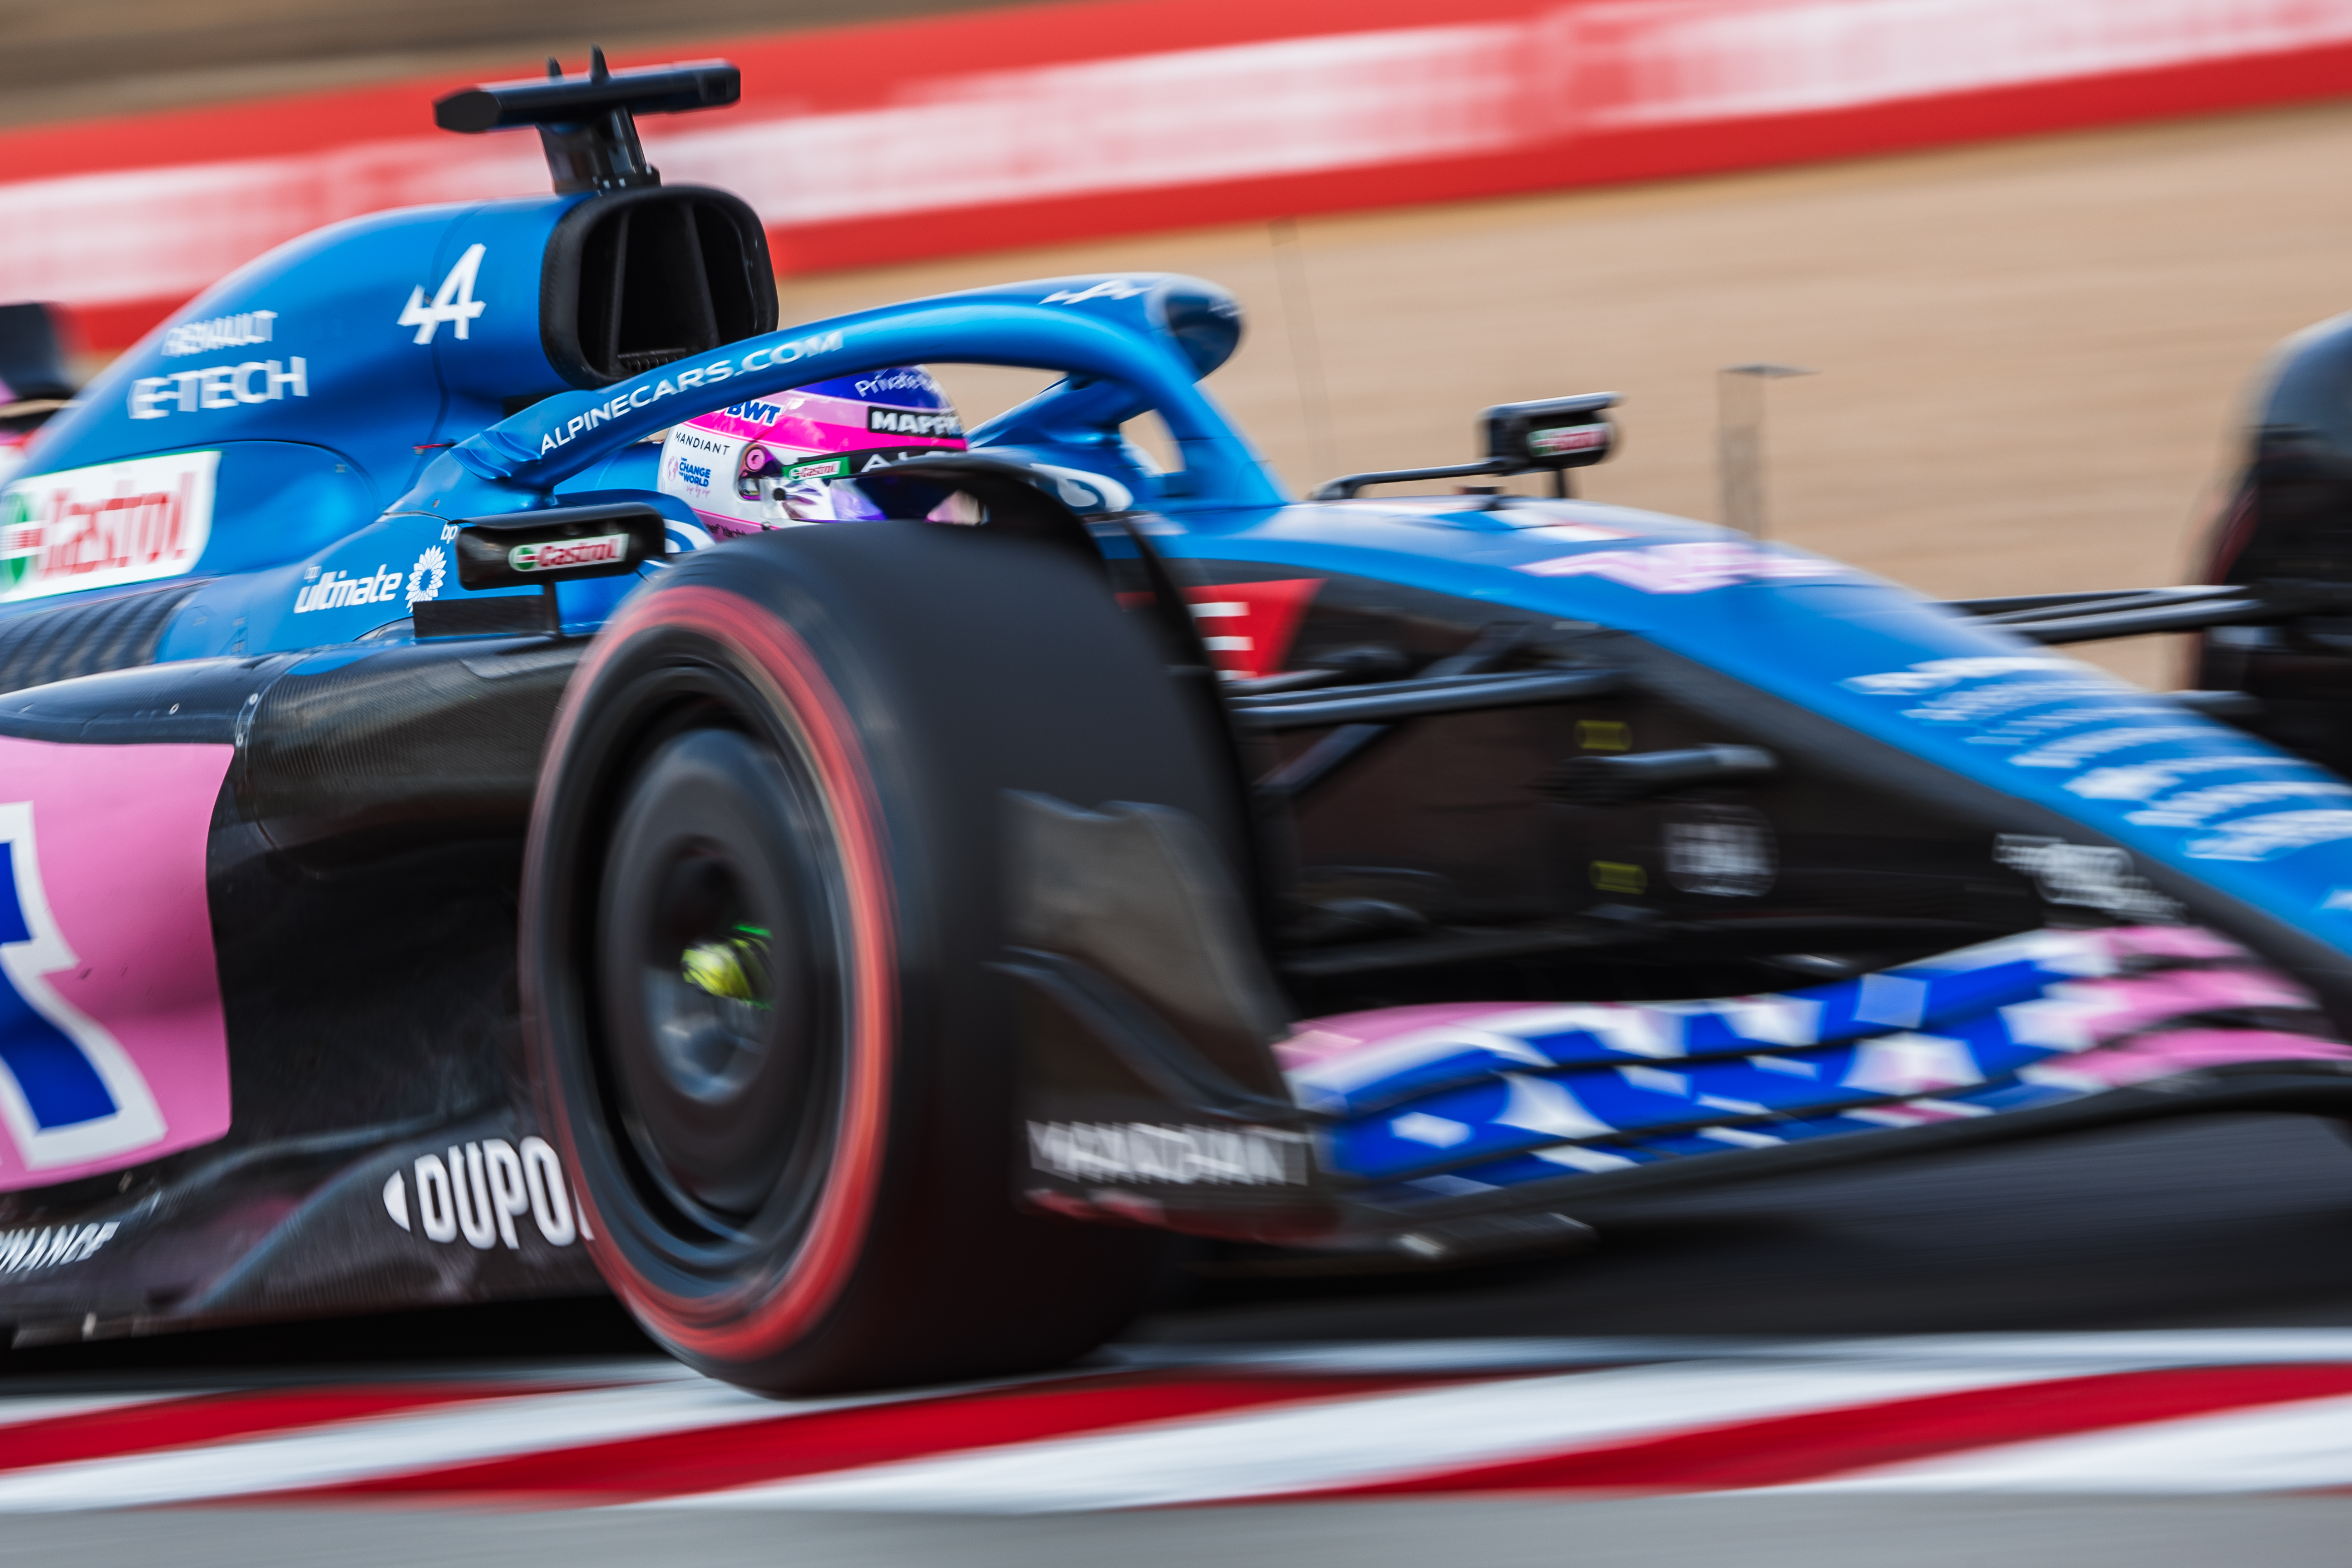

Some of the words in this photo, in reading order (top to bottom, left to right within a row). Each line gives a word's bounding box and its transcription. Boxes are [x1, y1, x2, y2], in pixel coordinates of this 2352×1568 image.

[126, 356, 310, 420] E-TECH
[540, 330, 844, 456] ALPINECARS.COM
[725, 399, 783, 426] BWT
[674, 431, 730, 455] MANDIANT
[680, 461, 711, 478] CHANGE
[684, 473, 709, 487] WORLD
[440, 523, 459, 544] bp
[294, 564, 403, 613] ultimate
[415, 1135, 595, 1250] DUPO
